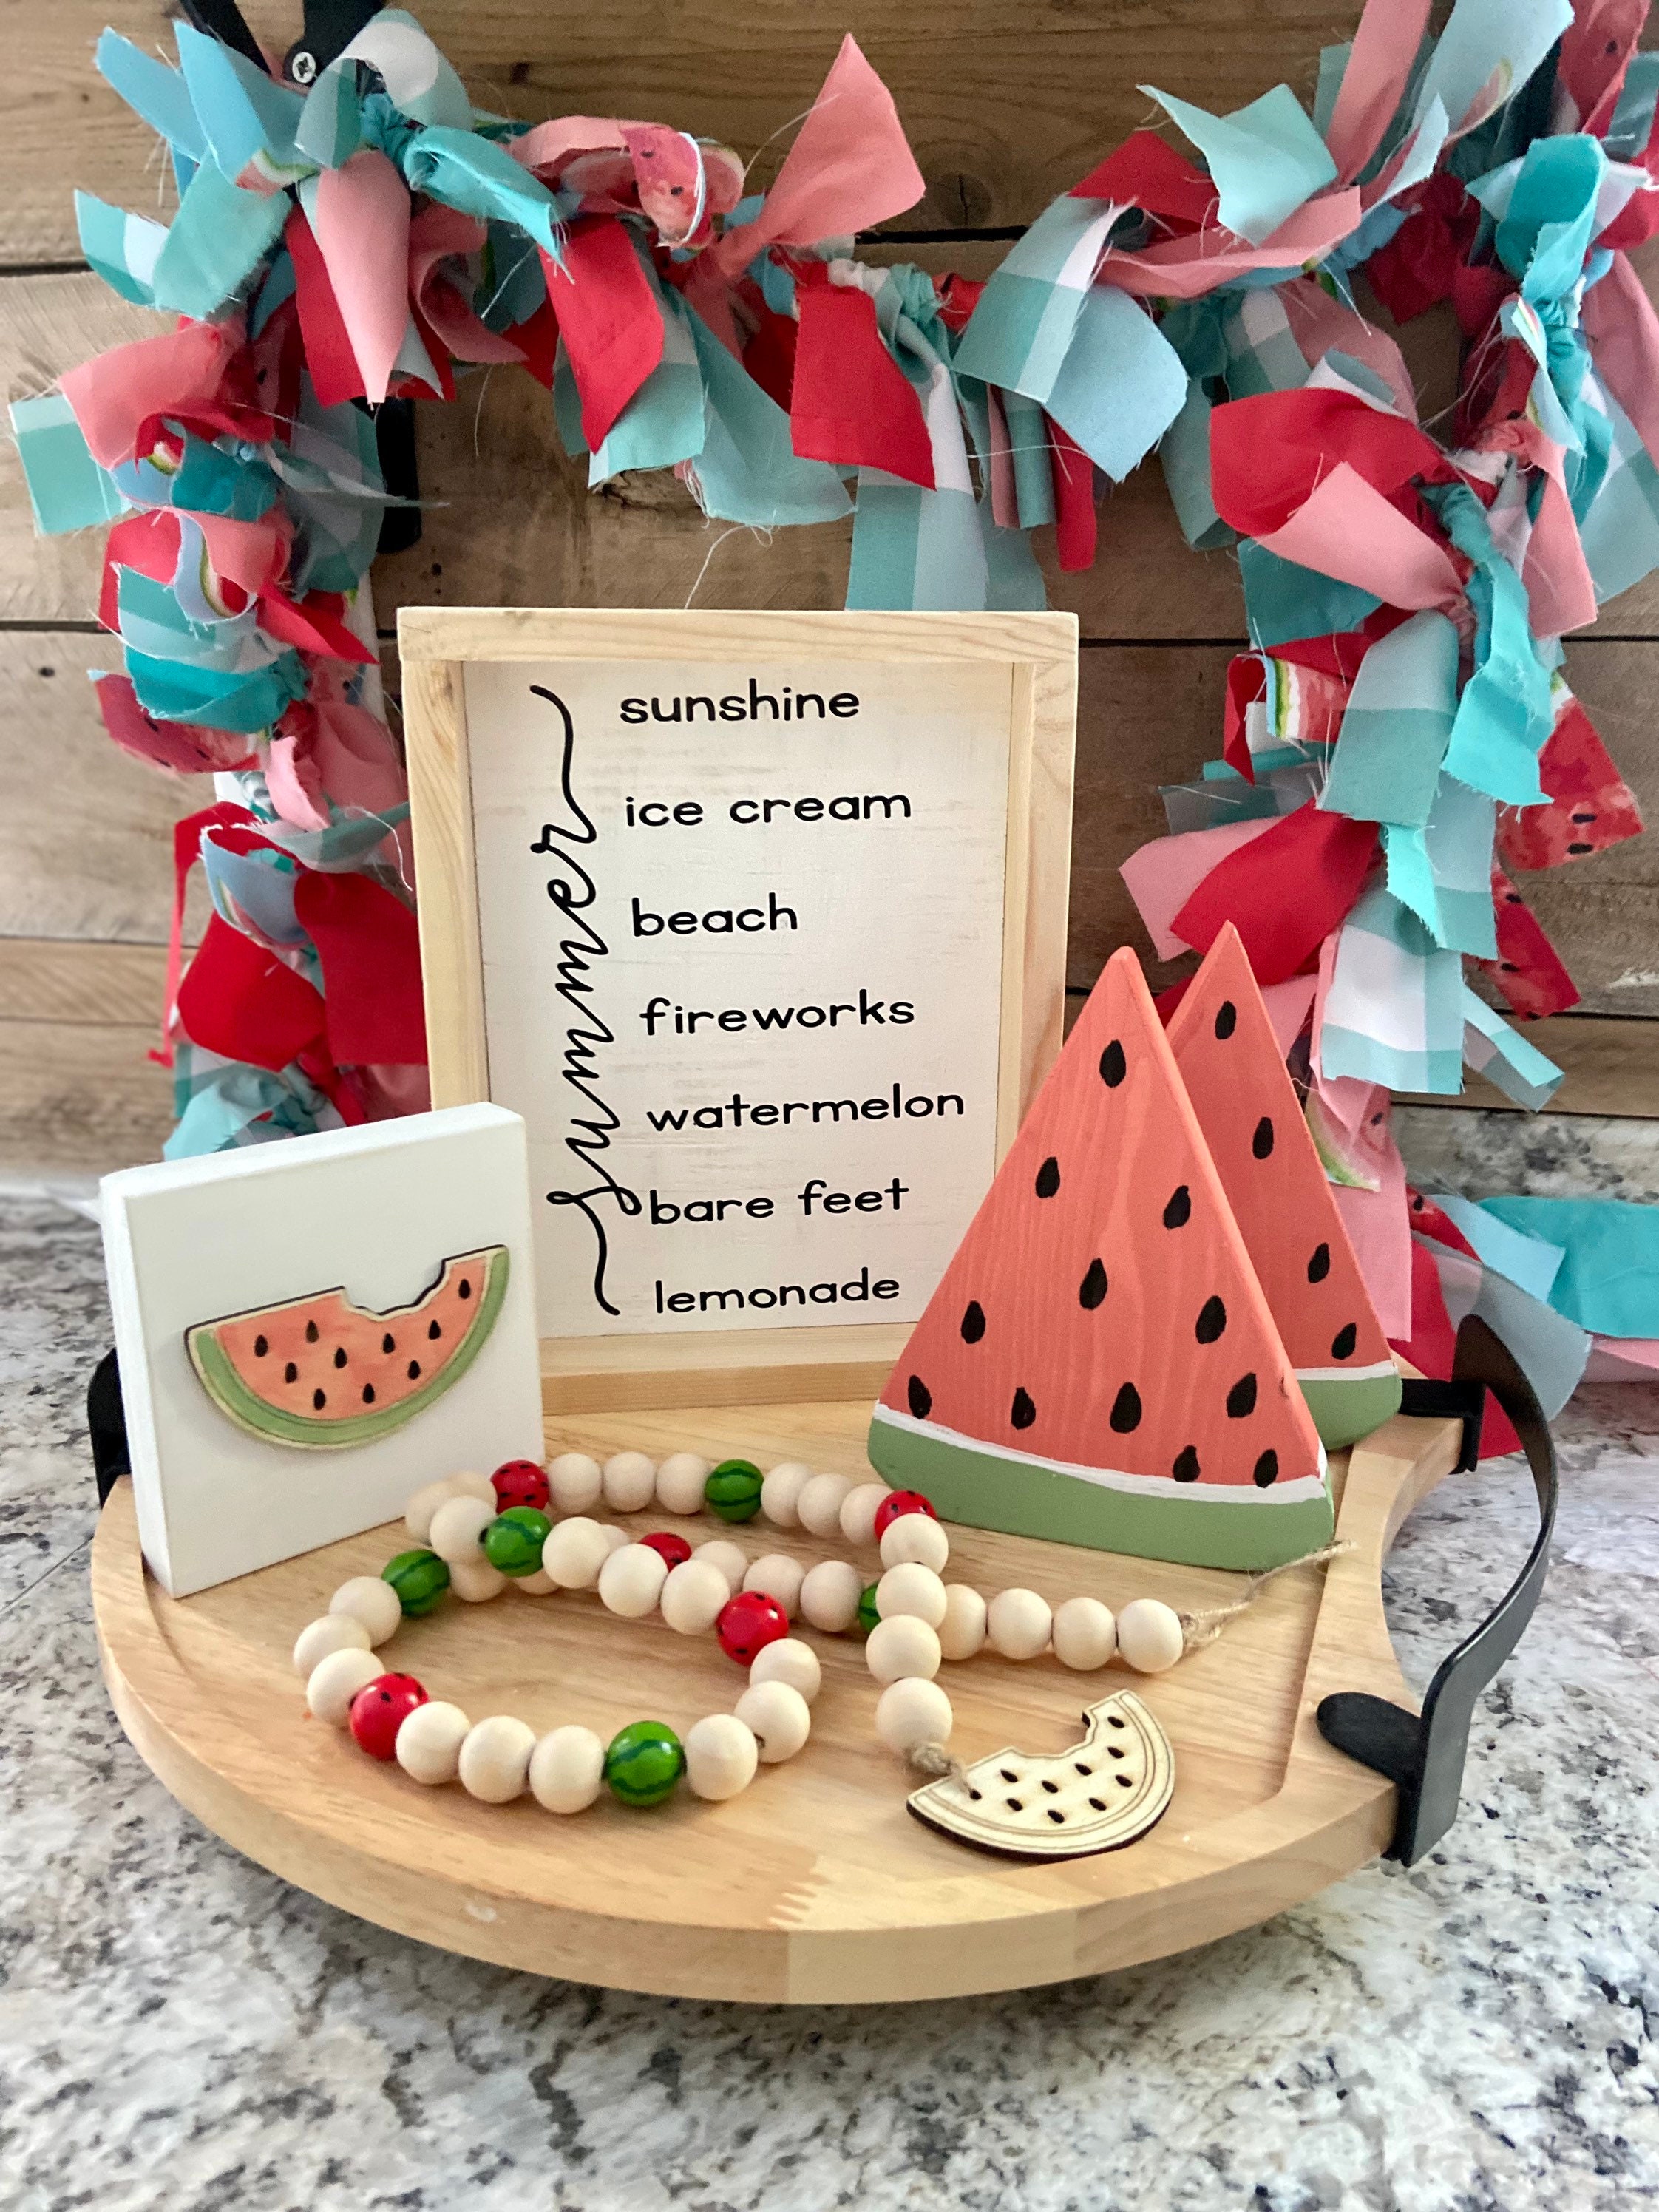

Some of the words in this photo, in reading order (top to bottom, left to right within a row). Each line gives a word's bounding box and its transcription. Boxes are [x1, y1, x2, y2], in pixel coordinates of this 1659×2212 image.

[619, 677, 861, 725] sunshine
[625, 796, 704, 827] ice
[729, 793, 912, 824] cream
[631, 891, 798, 938] beach
[639, 988, 915, 1037] fireworks
[645, 1082, 965, 1133] watermelon
[648, 1188, 775, 1226] bare
[796, 1177, 910, 1217] feet
[654, 1266, 900, 1314] lemonade
